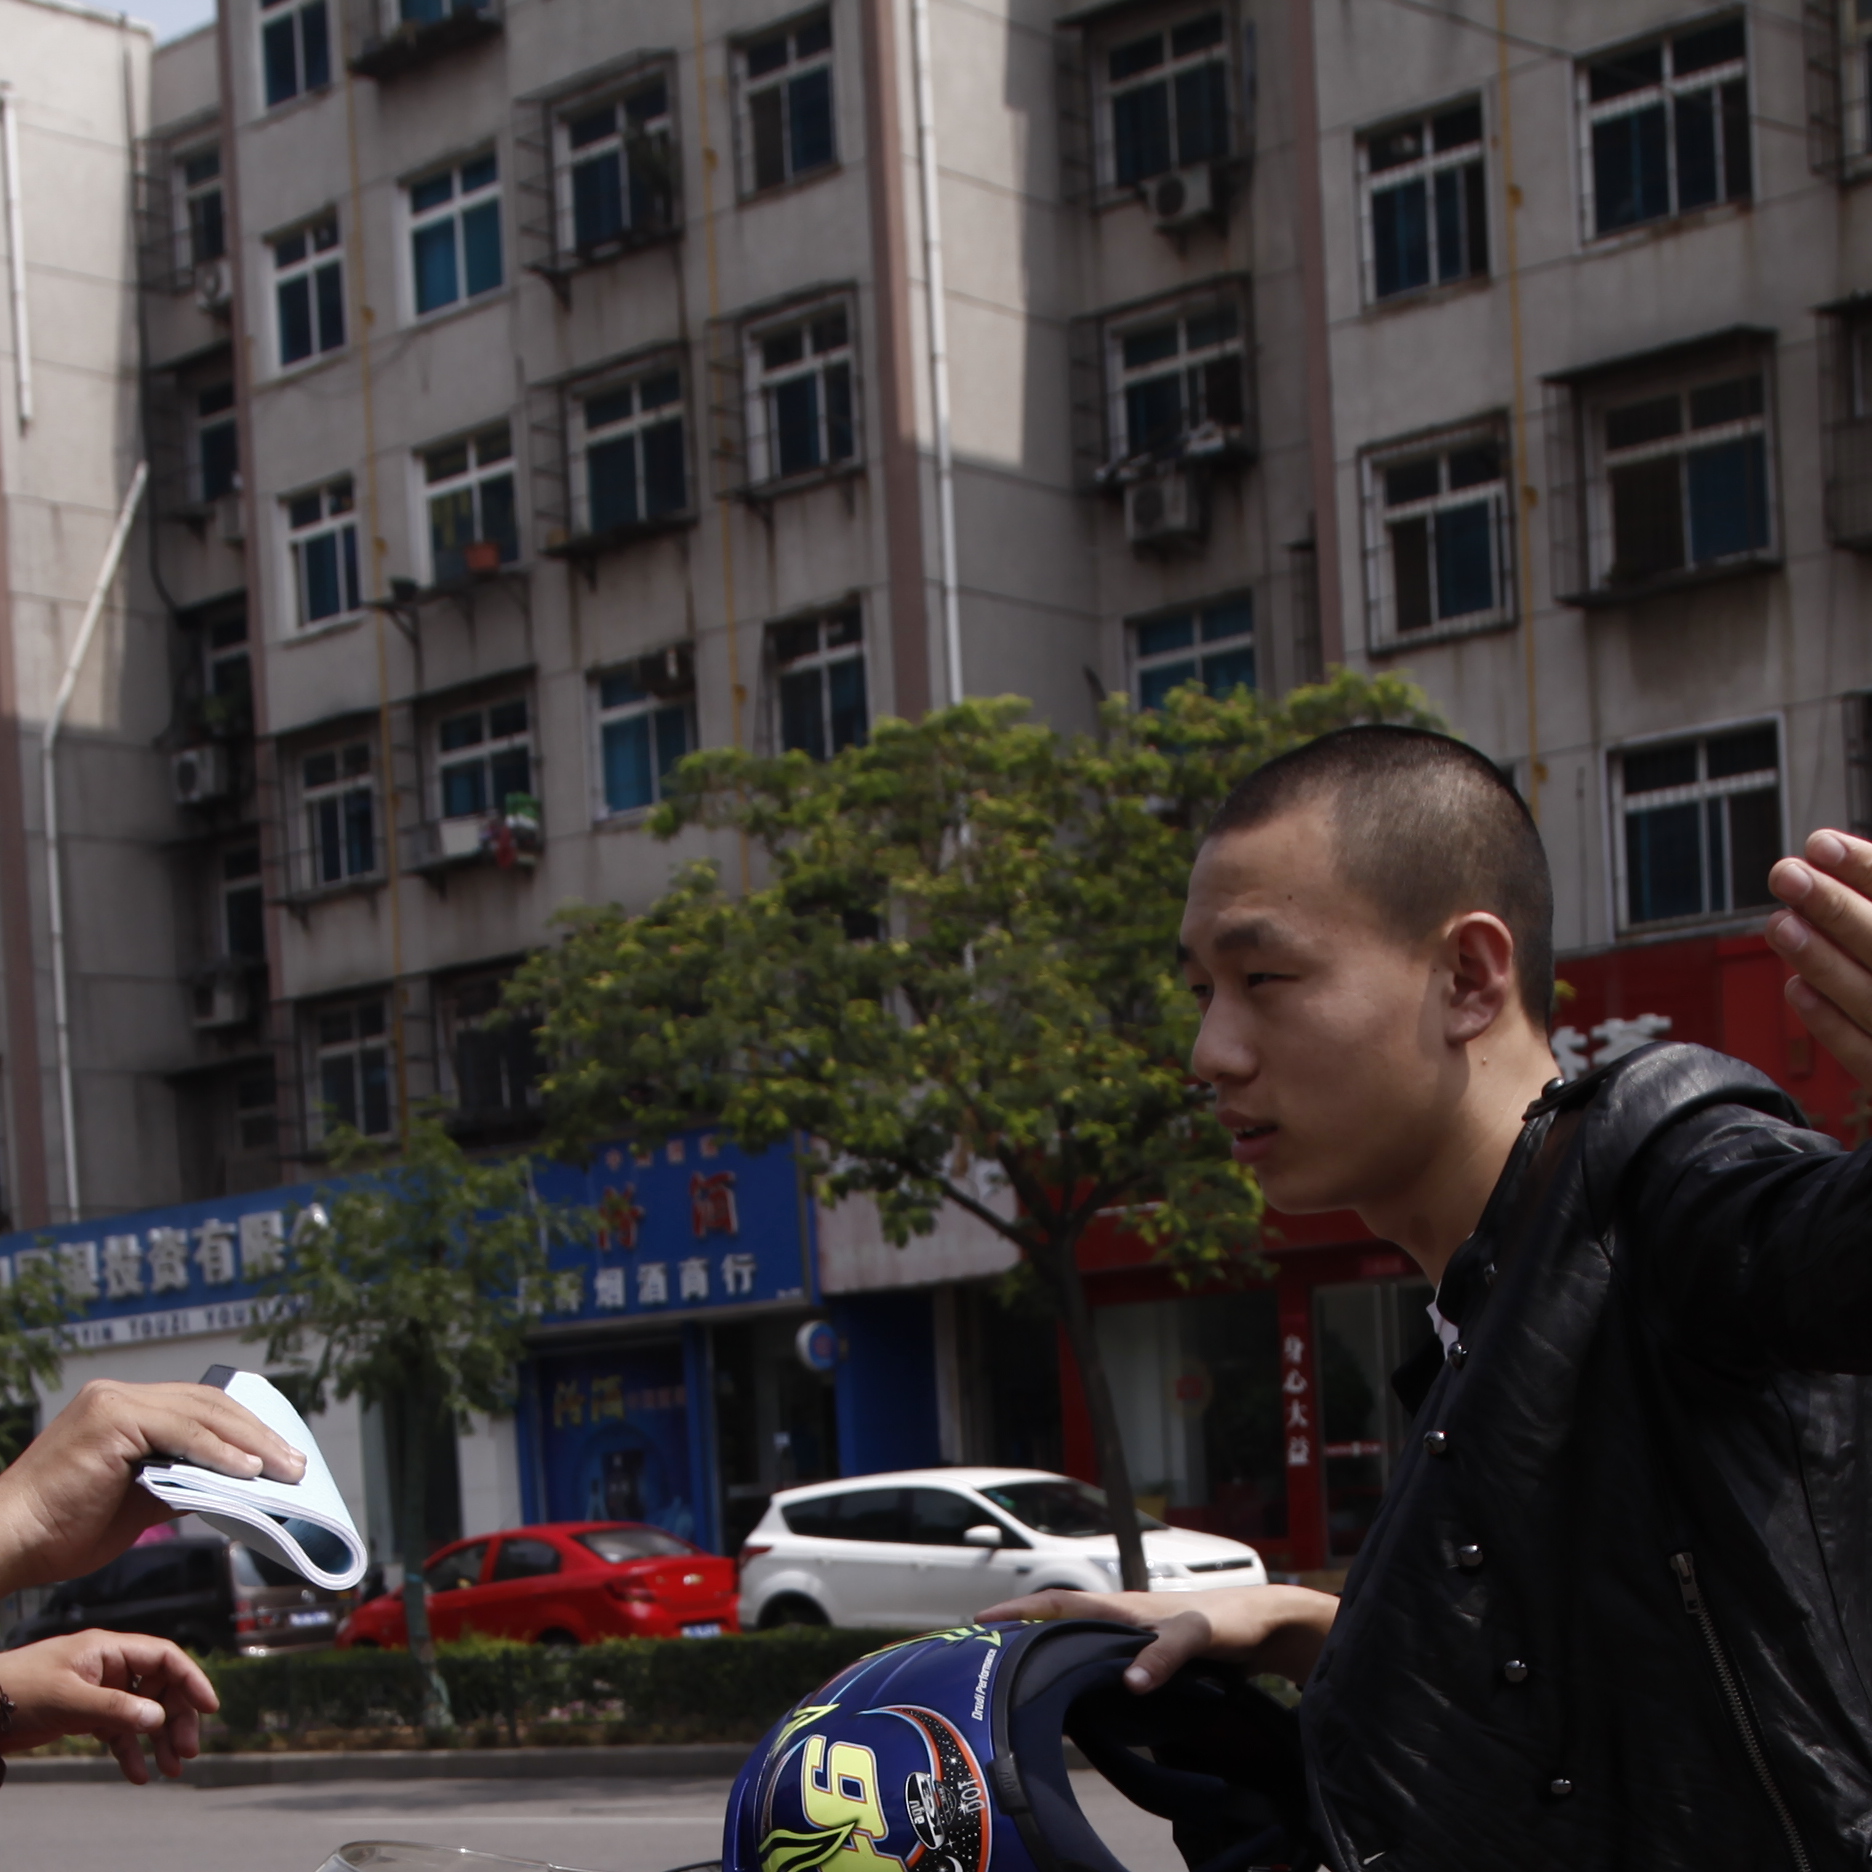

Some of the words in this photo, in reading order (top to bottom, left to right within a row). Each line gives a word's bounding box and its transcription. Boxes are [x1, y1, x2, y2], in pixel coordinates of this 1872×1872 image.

[1282, 1332, 1311, 1467] 身心大益
[971, 1692, 986, 1722] Drudi
[908, 1799, 926, 1825] agv
[958, 1779, 986, 1814] DOT
